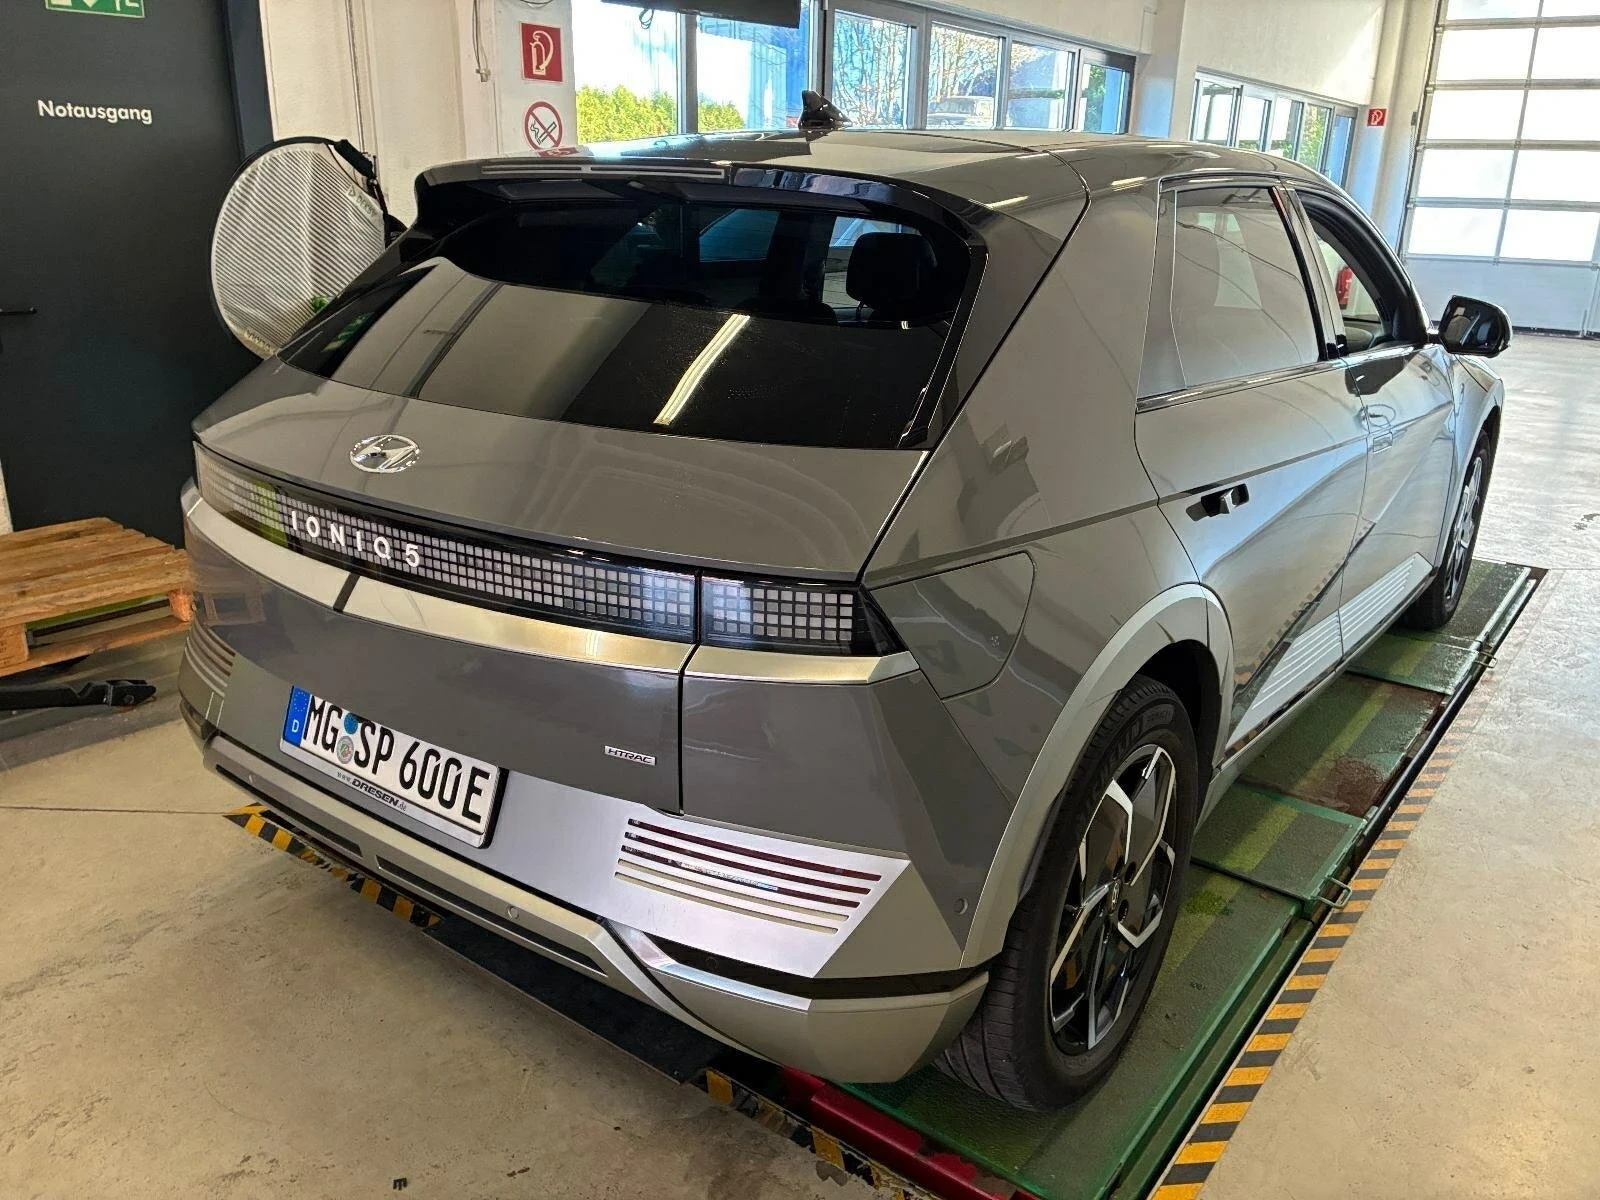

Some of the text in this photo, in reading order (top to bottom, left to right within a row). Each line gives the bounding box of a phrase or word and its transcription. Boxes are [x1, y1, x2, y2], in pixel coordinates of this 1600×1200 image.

[37, 99, 152, 125] Notausgang
[291, 510, 420, 568] IONIQ 5
[292, 696, 490, 824] D MG SP 600E
[607, 748, 652, 764] HTRAC
